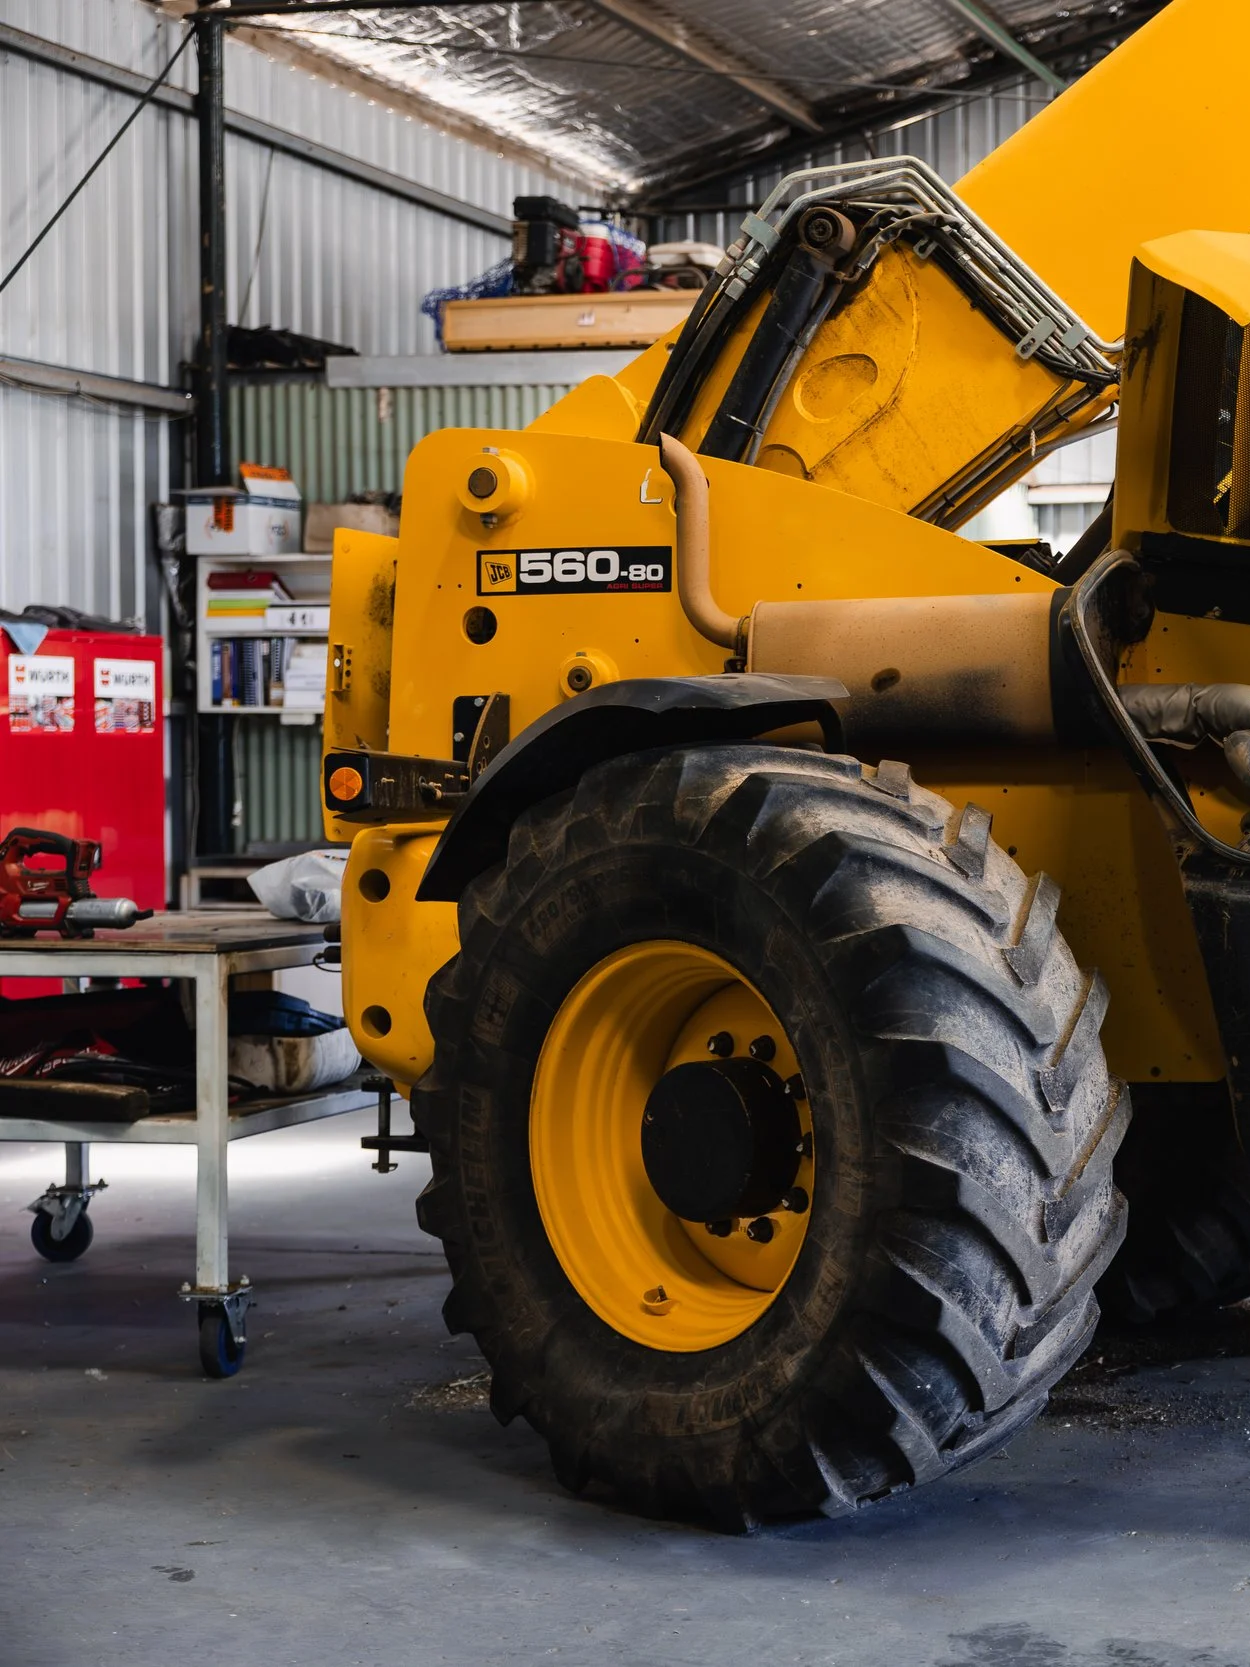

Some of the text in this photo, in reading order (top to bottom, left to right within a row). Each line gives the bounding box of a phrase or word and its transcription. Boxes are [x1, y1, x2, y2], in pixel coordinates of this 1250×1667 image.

[490, 564, 511, 582] JCB
[519, 550, 664, 584] 560-80
[631, 582, 664, 590] SUPER
